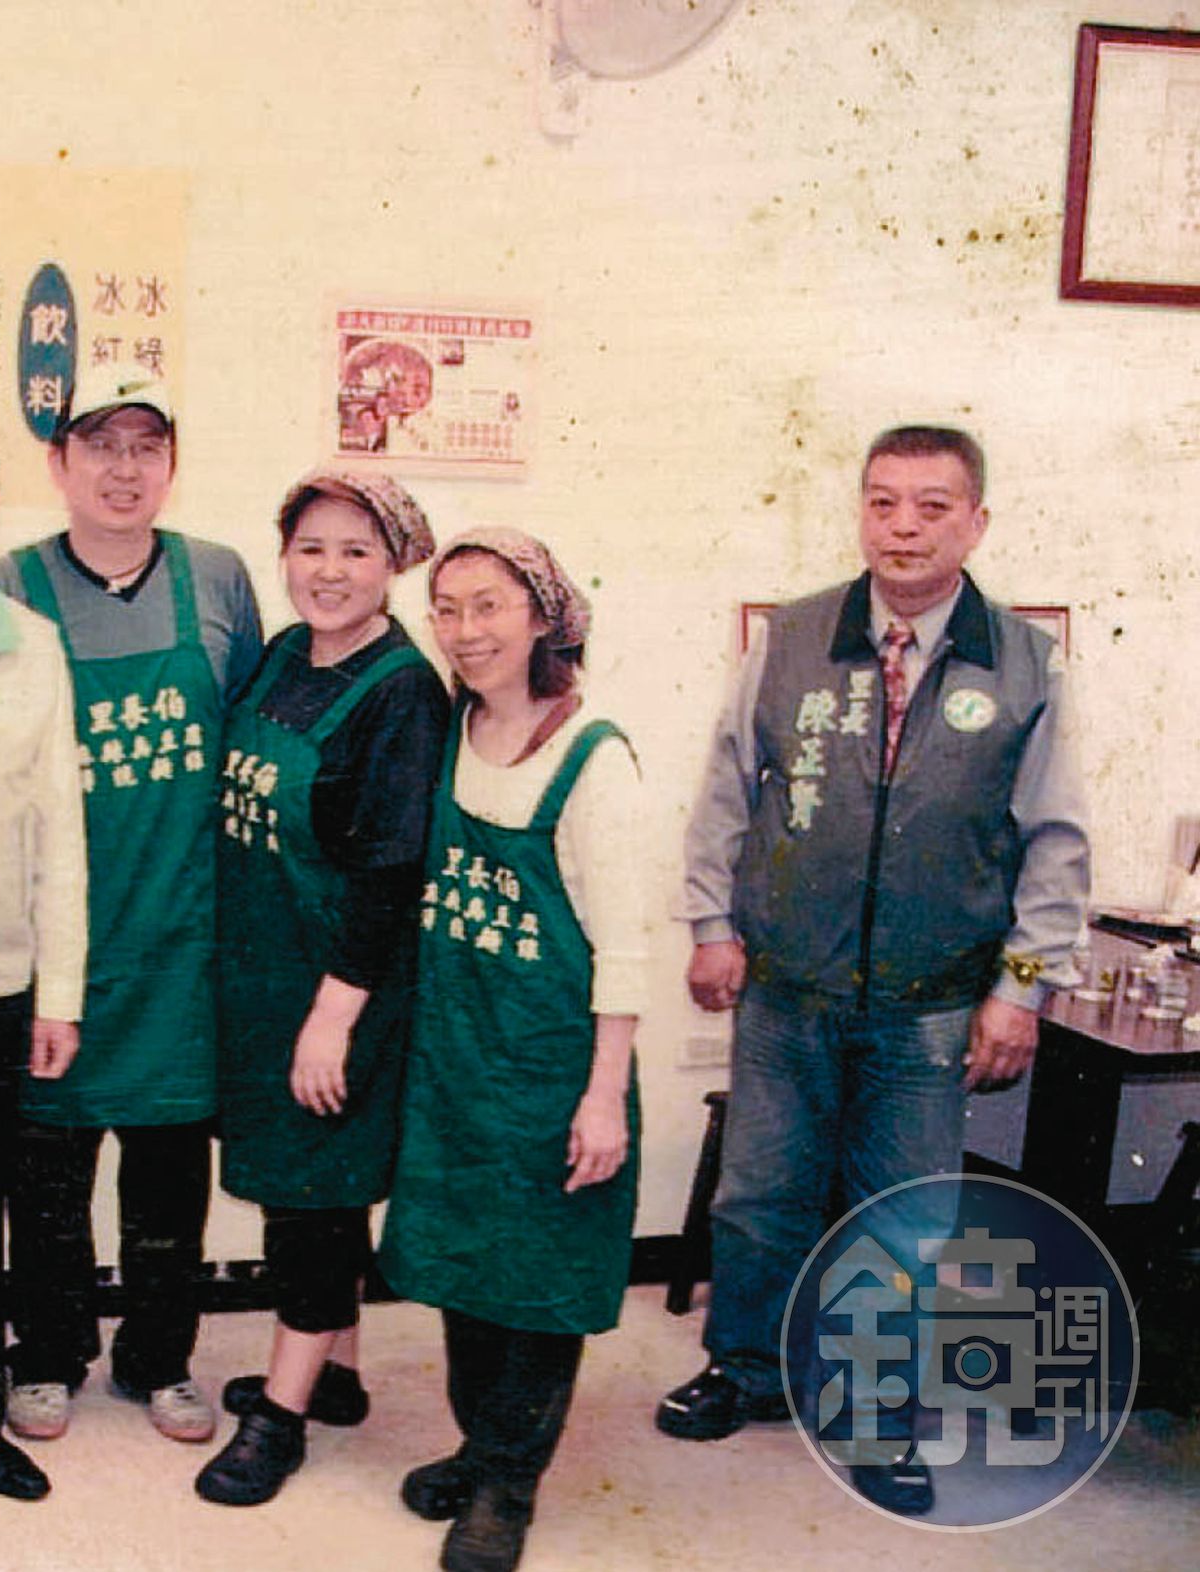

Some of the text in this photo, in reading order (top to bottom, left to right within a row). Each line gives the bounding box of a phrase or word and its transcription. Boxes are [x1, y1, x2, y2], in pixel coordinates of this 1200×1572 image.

[26, 303, 70, 416] 飲料
[88, 685, 186, 735] 里長伯
[440, 846, 521, 902] 里長伯
